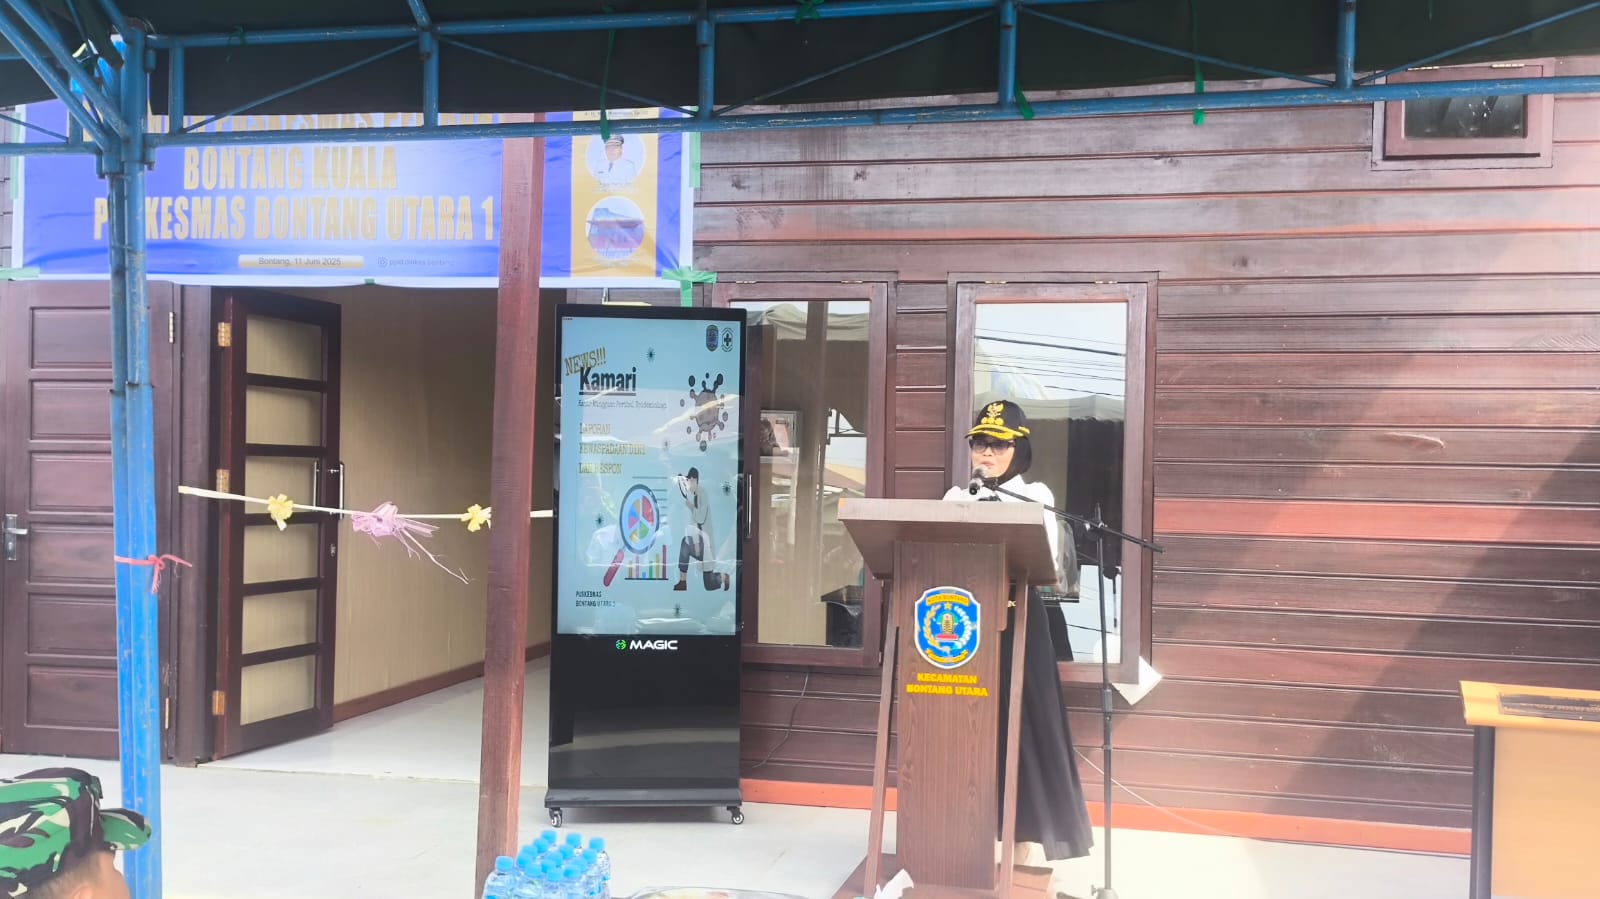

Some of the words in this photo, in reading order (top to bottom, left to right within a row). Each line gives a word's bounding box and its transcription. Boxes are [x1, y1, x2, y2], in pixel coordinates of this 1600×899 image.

[183, 146, 303, 190] BONTANG
[311, 145, 397, 190] KUALA
[93, 196, 246, 240] PKESMAS
[254, 196, 377, 240] BONTANG
[387, 195, 474, 240] UTARA
[481, 195, 494, 240] 1
[304, 256, 321, 265] Juni
[564, 348, 606, 376] NEWS!!!
[579, 366, 636, 391] Kamari
[629, 640, 679, 650] MAGIC
[917, 673, 978, 684] KECAMATAN
[906, 684, 953, 695] BONTANG
[955, 686, 988, 697] UTARA
